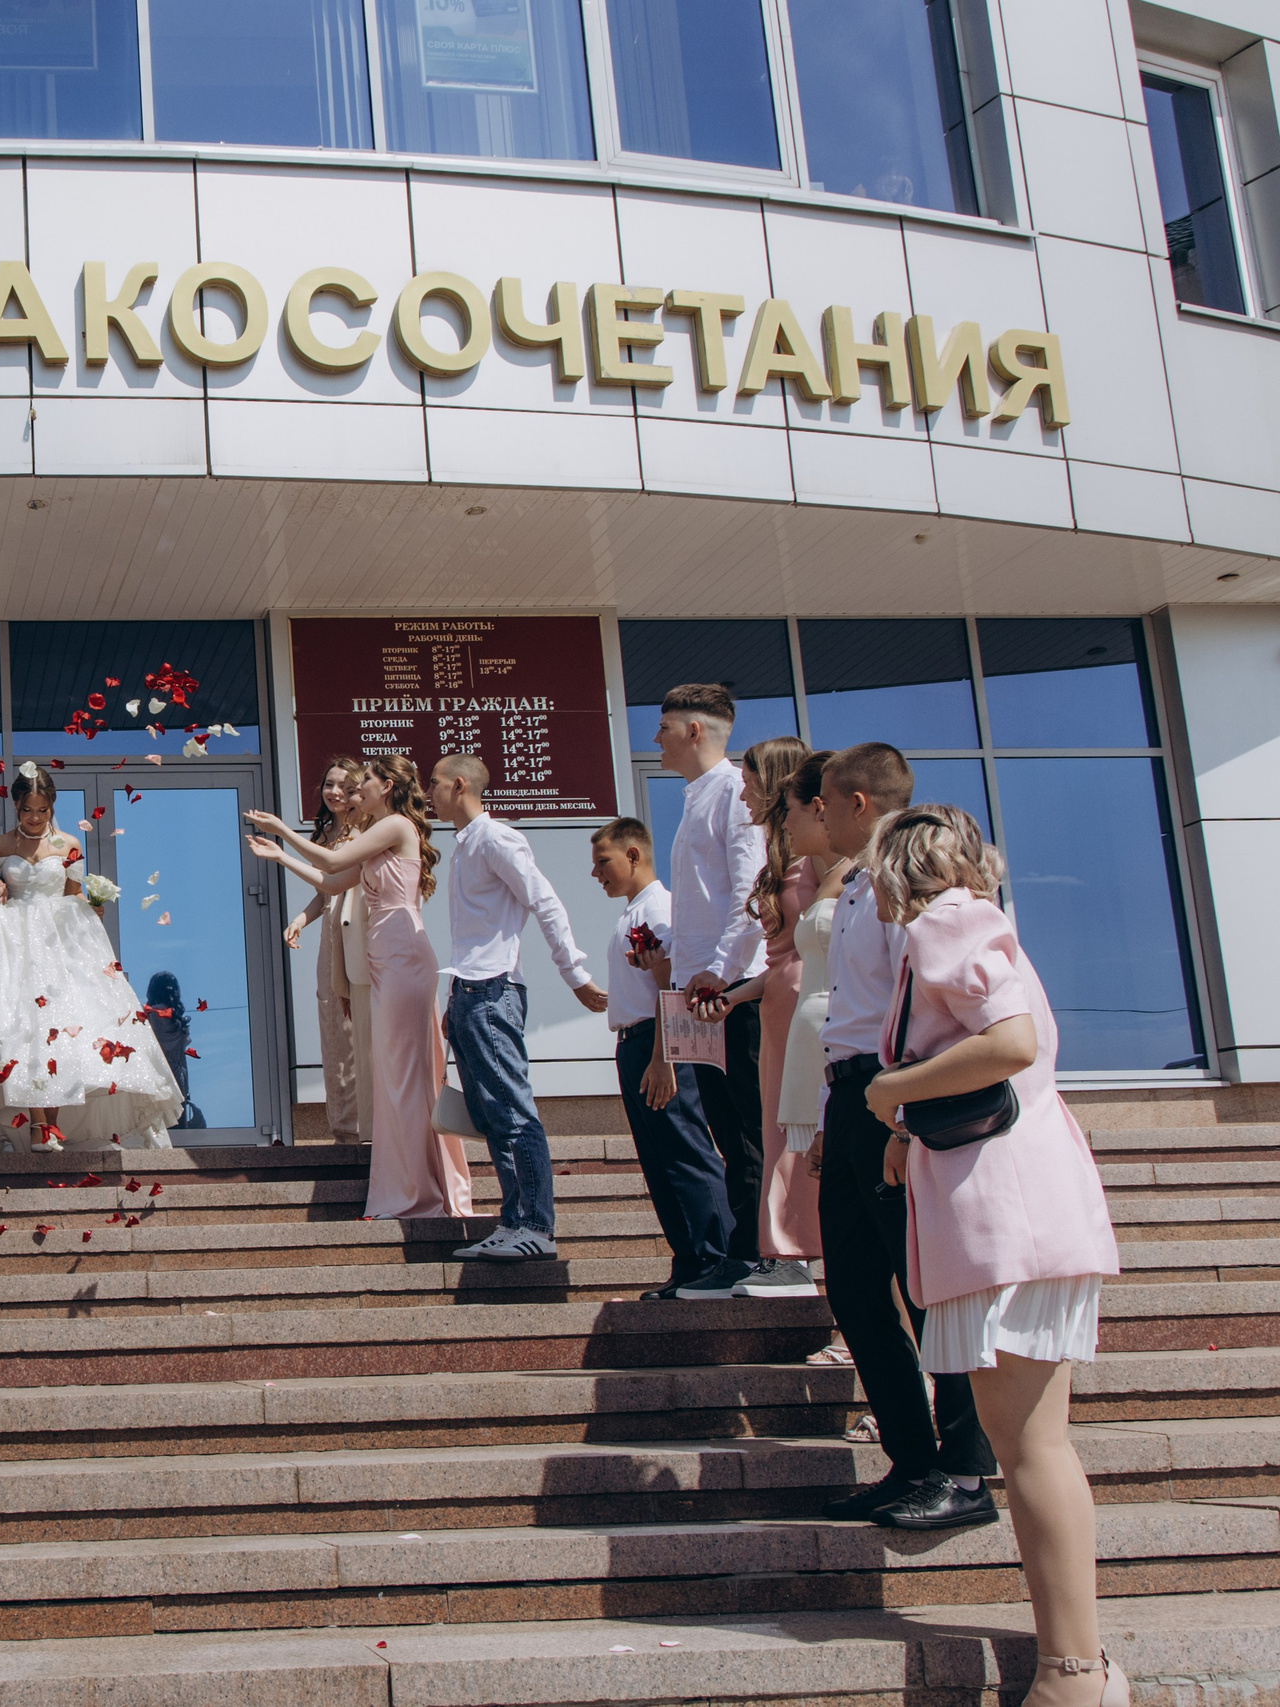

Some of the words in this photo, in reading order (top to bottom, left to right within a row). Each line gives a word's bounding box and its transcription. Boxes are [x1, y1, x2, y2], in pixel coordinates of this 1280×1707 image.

[427, 40, 455, 49] СВОЯ
[457, 42, 489, 52] КАРТА
[490, 44, 522, 54] ПЛЮС
[394, 622, 439, 631] РЕЖИМ
[442, 622, 495, 631] РАБОТЫ:
[408, 633, 453, 642] РАБОЧИЙ
[455, 635, 483, 643] ДЕНЬ:
[352, 694, 434, 712] ПРИЁМ
[438, 696, 555, 714] ГРАЖДАН:
[360, 719, 414, 728] ВТОРНИК
[360, 733, 398, 743] СРЕДА
[362, 747, 413, 756] ЧЕТВЕРГ
[493, 788, 559, 797] ПОНЕДЕЛЬНИК
[535, 803, 559, 811] ДЕНЬ
[560, 802, 596, 810] МЕСЯЦА
